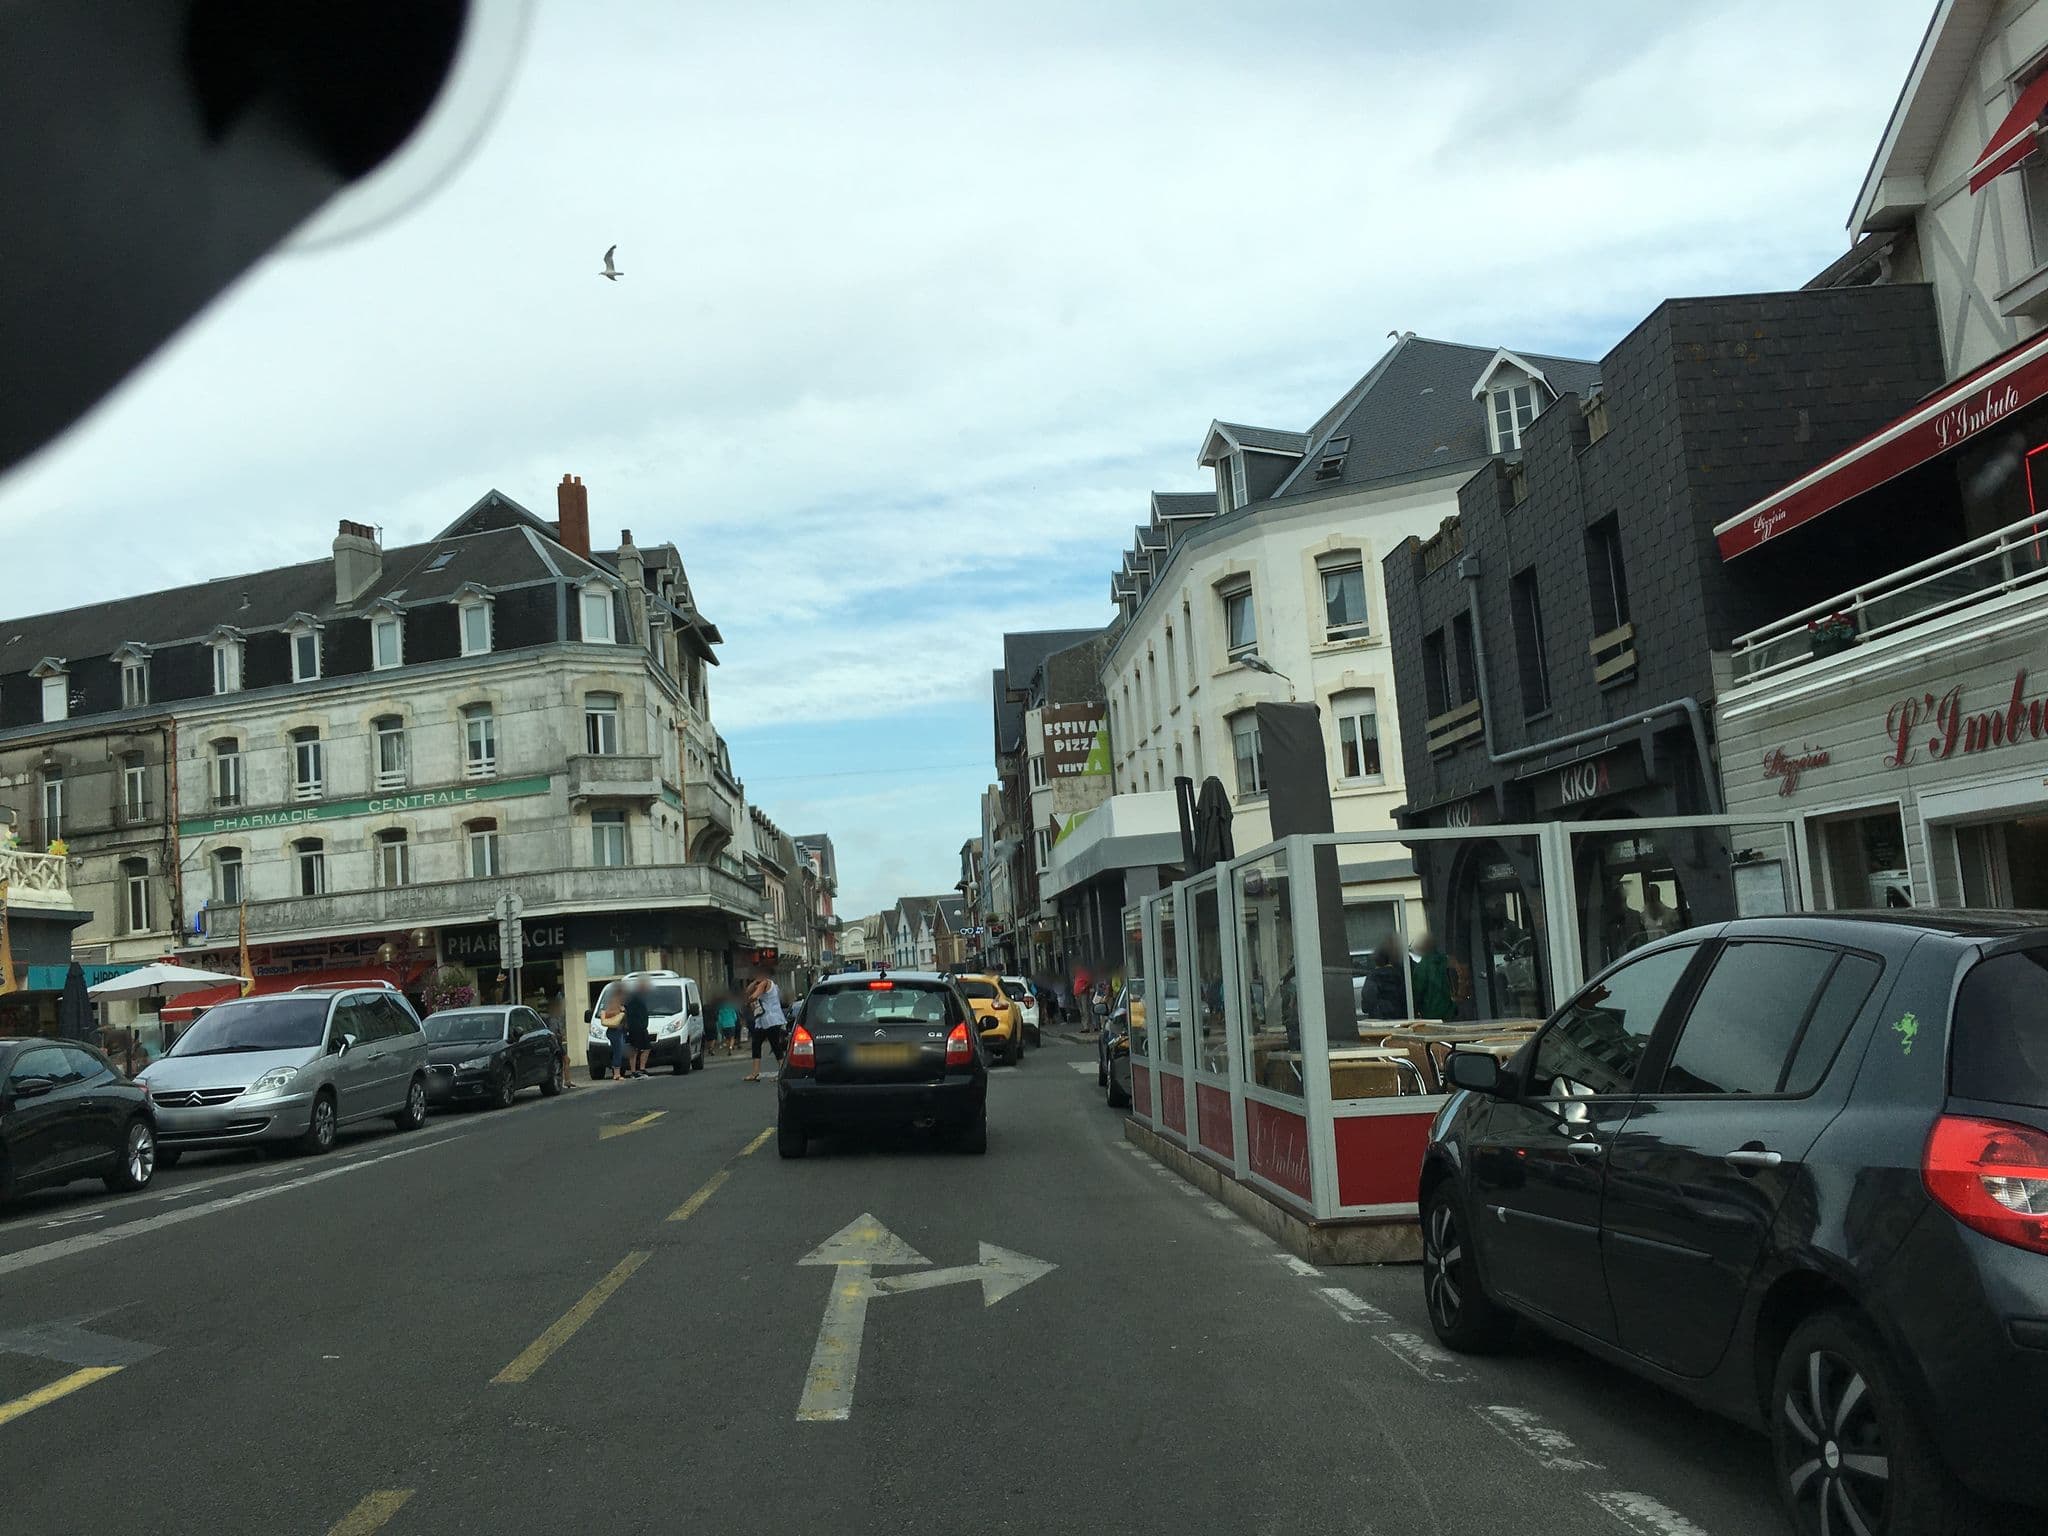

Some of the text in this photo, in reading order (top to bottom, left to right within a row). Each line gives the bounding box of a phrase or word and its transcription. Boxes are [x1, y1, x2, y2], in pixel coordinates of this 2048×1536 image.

[1935, 385, 2019, 448] L'Imbuto
[1053, 737, 1101, 753] PIZZA
[213, 788, 478, 831] PHARMACIE CENTRALE
[448, 926, 565, 955] PHARACIE
